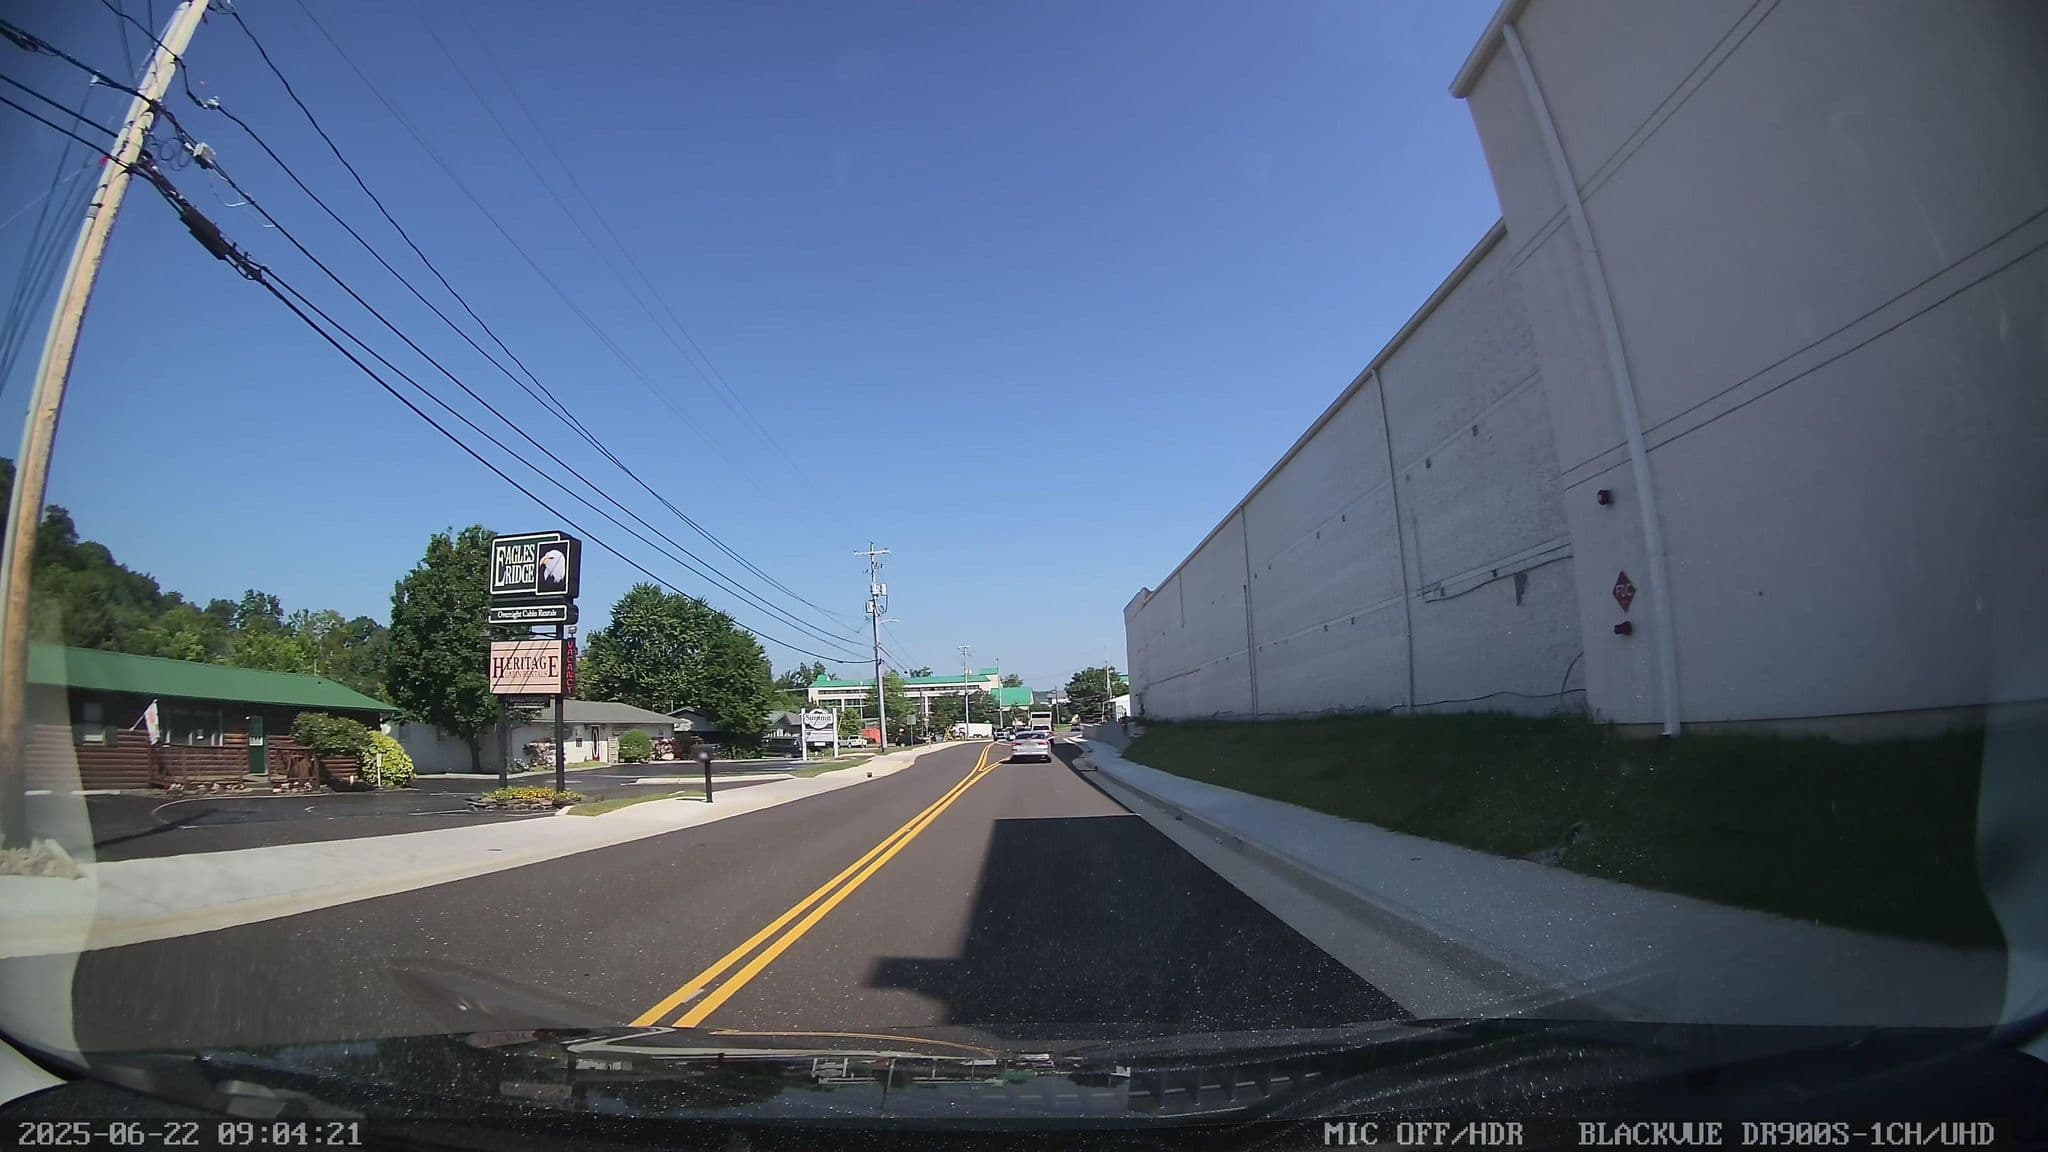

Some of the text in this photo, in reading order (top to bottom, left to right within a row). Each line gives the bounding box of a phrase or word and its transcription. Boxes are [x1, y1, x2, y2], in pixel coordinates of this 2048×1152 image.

[494, 544, 535, 587] EAGLES
[505, 564, 535, 584] RIDGE
[522, 609, 537, 617] Cabin
[538, 609, 557, 617] Rentals
[493, 656, 559, 678] HERITAGE
[566, 641, 574, 694] VACANCY
